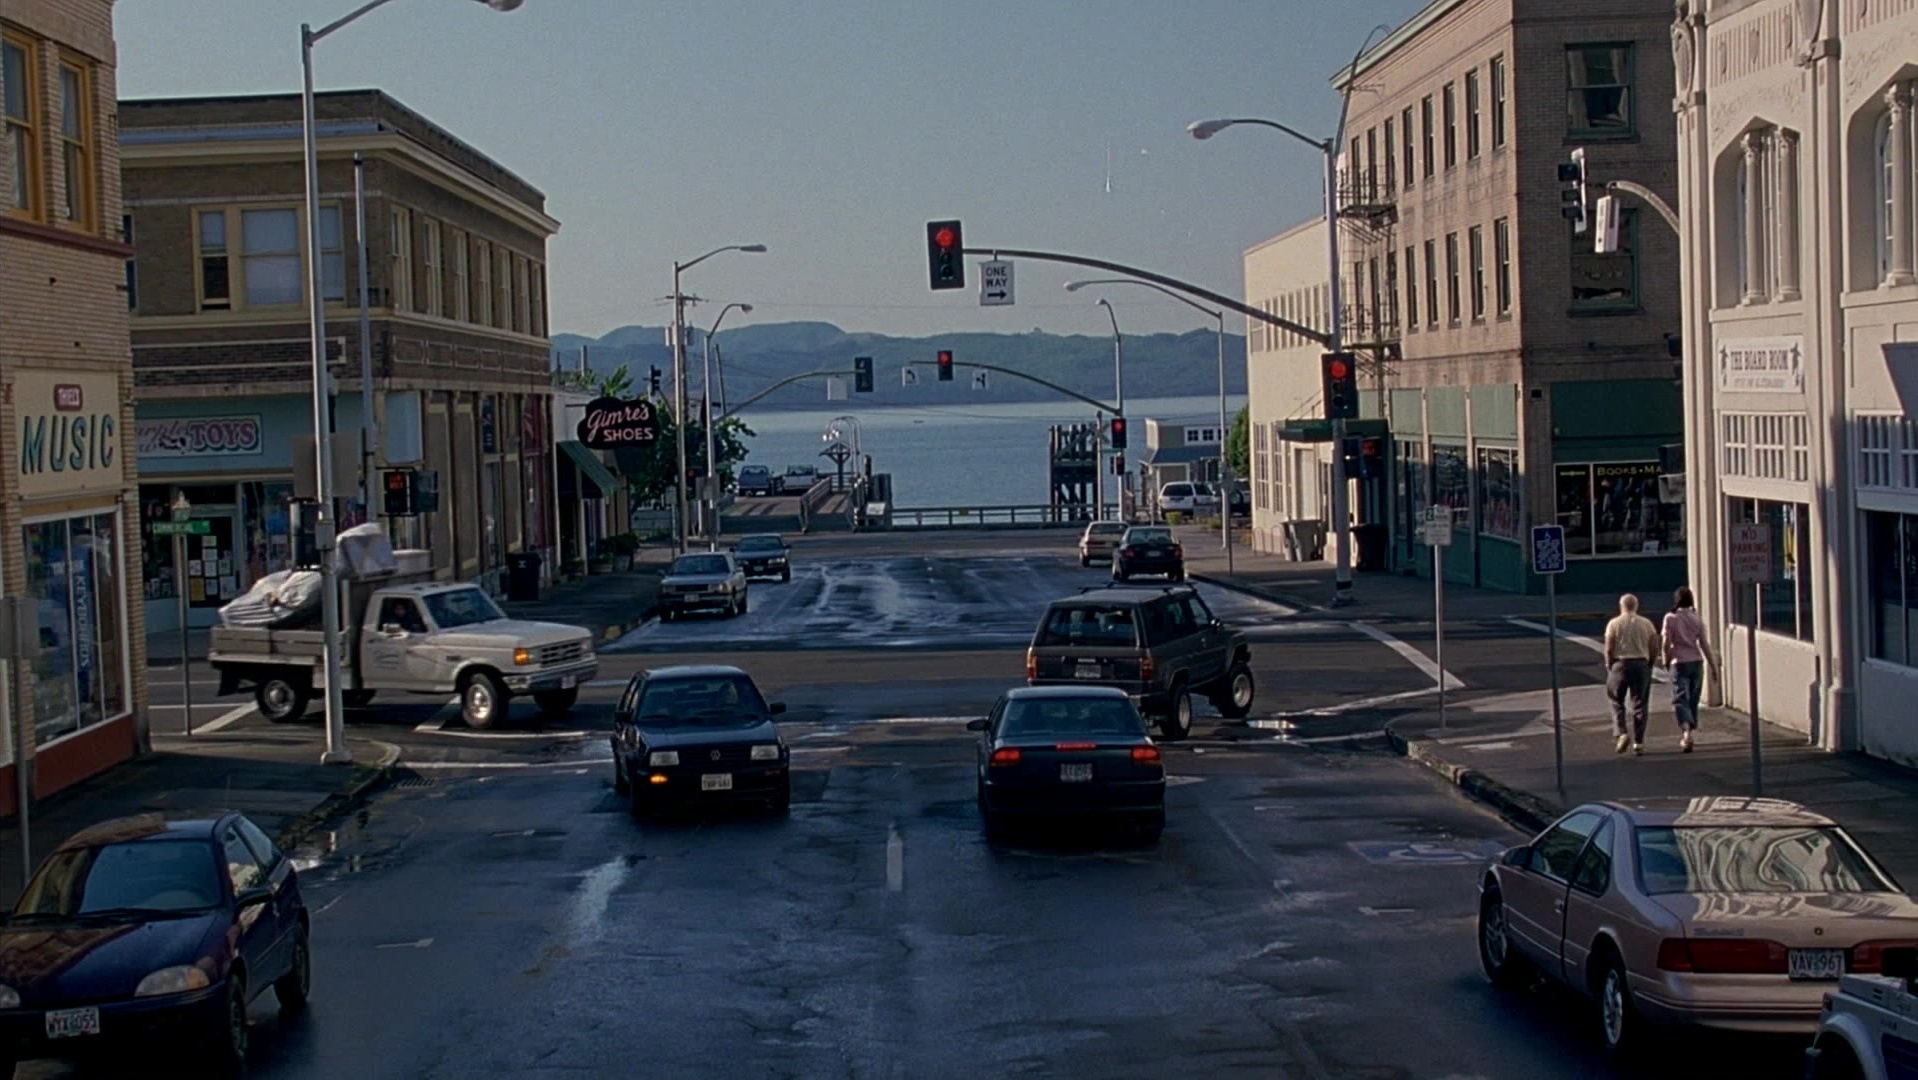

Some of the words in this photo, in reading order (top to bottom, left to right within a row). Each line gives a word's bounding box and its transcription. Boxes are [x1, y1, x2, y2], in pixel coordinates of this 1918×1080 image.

[985, 266, 1006, 277] ONE
[985, 278, 1007, 288] WAY
[1730, 350, 1743, 370] THE
[1745, 350, 1767, 370] BOARD
[1769, 349, 1789, 370] ROOM
[189, 421, 257, 450] TOYS
[603, 427, 655, 442] SHOES
[21, 413, 115, 475] MUSIC
[1597, 466, 1637, 476] BOOKS
[1644, 465, 1662, 475] MA
[1741, 529, 1757, 541] NO
[1734, 543, 1767, 554] PARKING
[1790, 953, 1814, 970] VAV
[1820, 953, 1842, 971] 967
